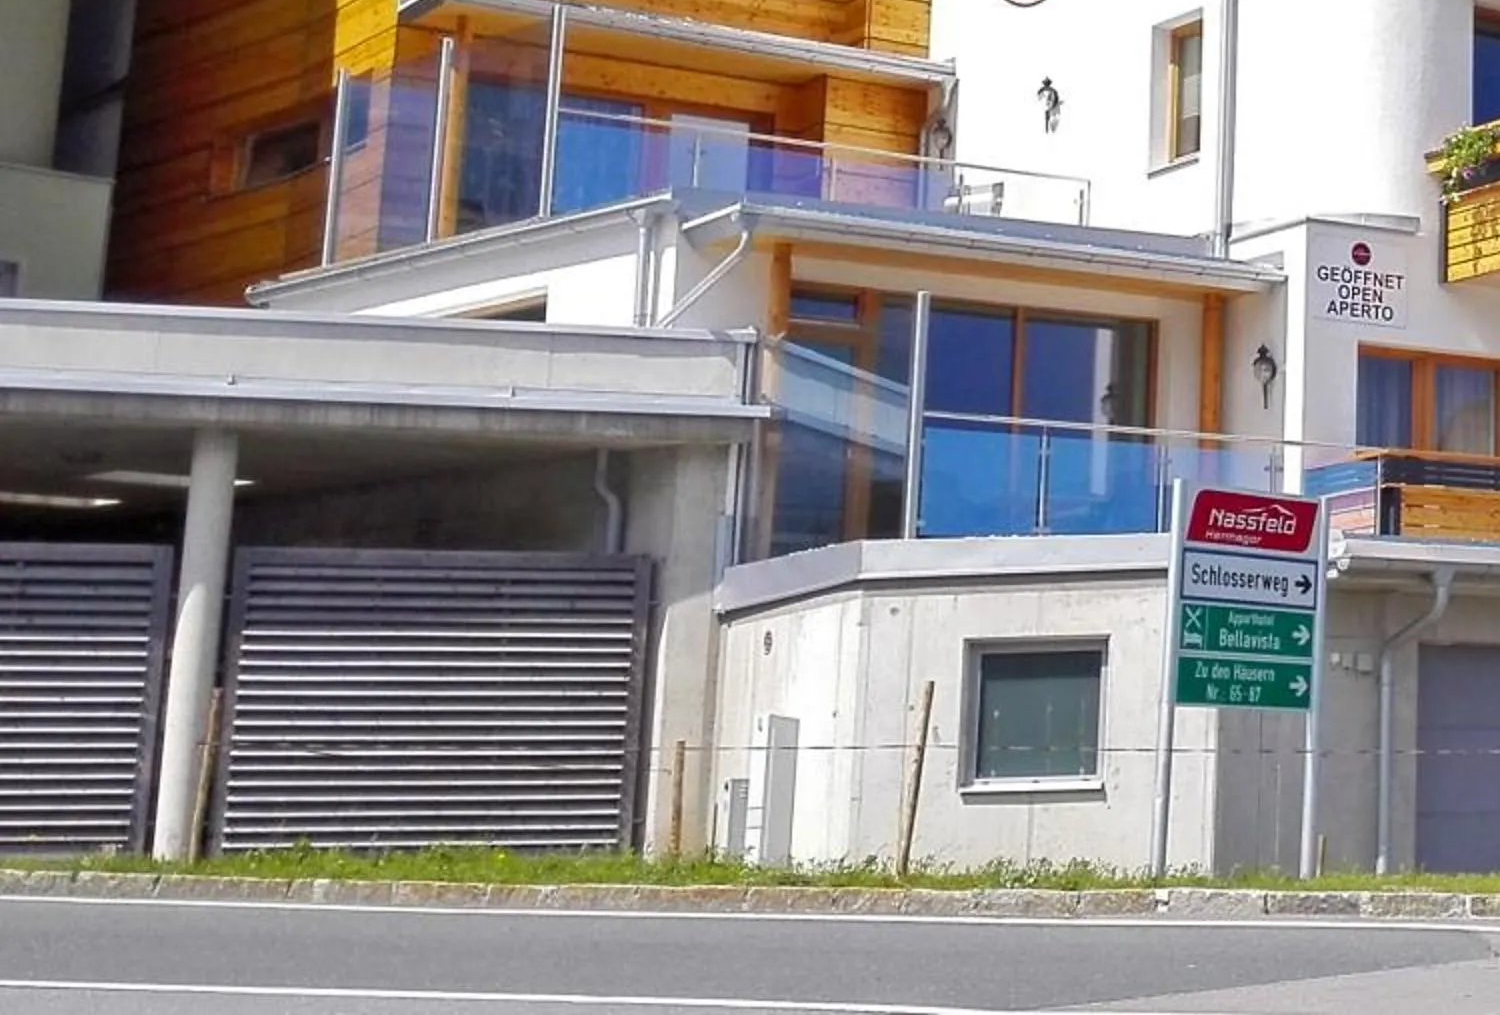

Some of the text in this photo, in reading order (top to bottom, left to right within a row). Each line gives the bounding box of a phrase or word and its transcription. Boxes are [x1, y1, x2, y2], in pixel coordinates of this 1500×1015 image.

[1317, 265, 1405, 290] GEÖFFNET
[1338, 284, 1384, 303] OPEN
[1327, 300, 1395, 321] APERTO
[1208, 507, 1297, 536] Nassfeld
[1191, 562, 1290, 597] Schlosserweg
[1219, 627, 1281, 650] Bellavista
[1194, 661, 1276, 683] Zu den Häusern
